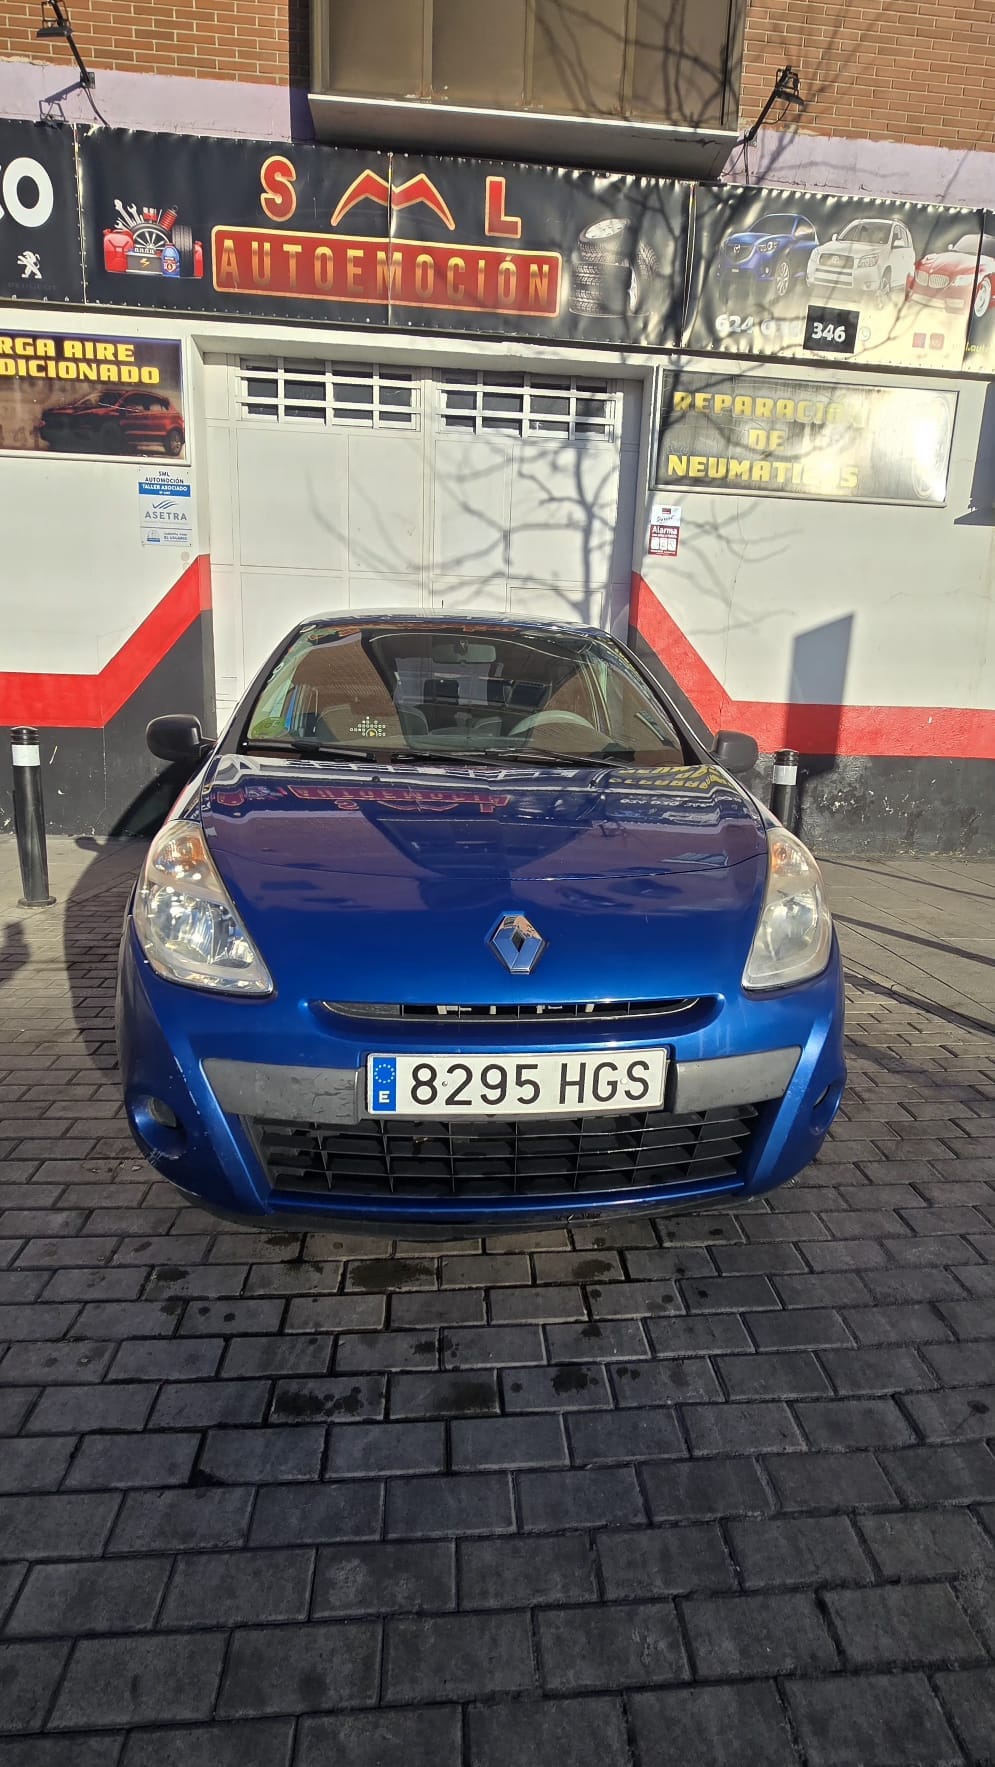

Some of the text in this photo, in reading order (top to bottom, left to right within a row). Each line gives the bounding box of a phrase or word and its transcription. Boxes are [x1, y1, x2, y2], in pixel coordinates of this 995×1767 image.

[220, 239, 549, 305] AUTOEMOCIÓN
[811, 321, 846, 343] 346
[63, 340, 135, 362] AIRE
[749, 429, 786, 451] DE
[145, 511, 188, 521] ASETRA
[653, 525, 678, 535] Alarma
[410, 1060, 650, 1106] 8295 HGS
[378, 1090, 390, 1103] E
